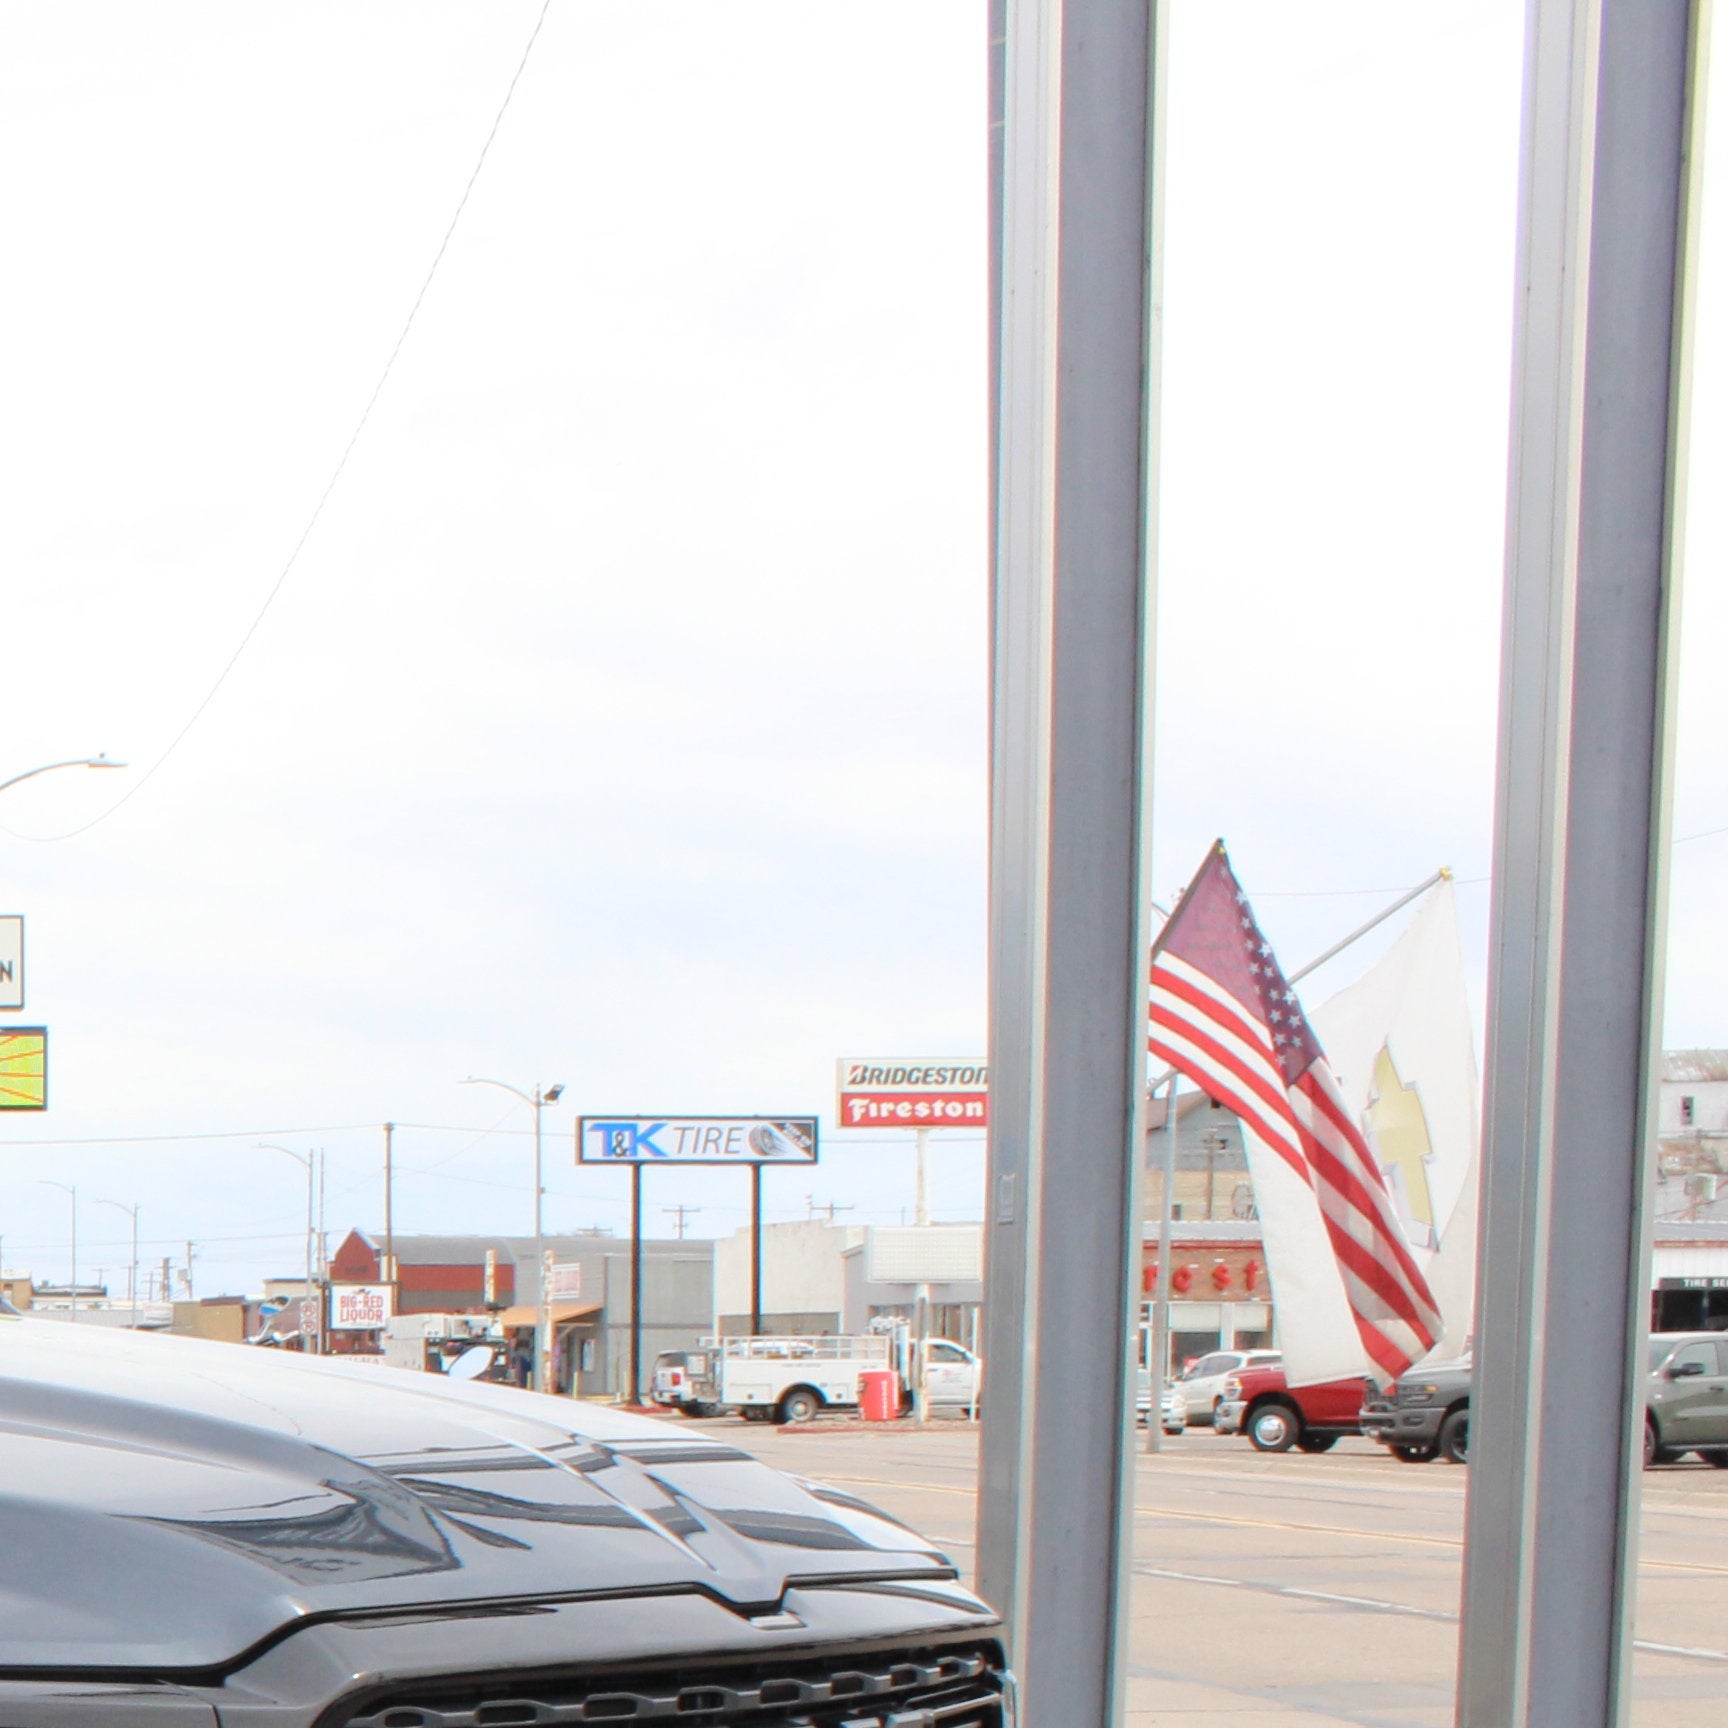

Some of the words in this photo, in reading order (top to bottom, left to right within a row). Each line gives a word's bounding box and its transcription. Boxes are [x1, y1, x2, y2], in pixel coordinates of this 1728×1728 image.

[847, 1064, 989, 1086] BRIDGESTON
[847, 1097, 985, 1123] Fireston
[587, 1122, 670, 1158] T&K
[673, 1126, 744, 1155] TIRE
[1684, 1278, 1708, 1288] TIRE
[1711, 1278, 1728, 1288] SE
[339, 1309, 383, 1323] LIQUOR
